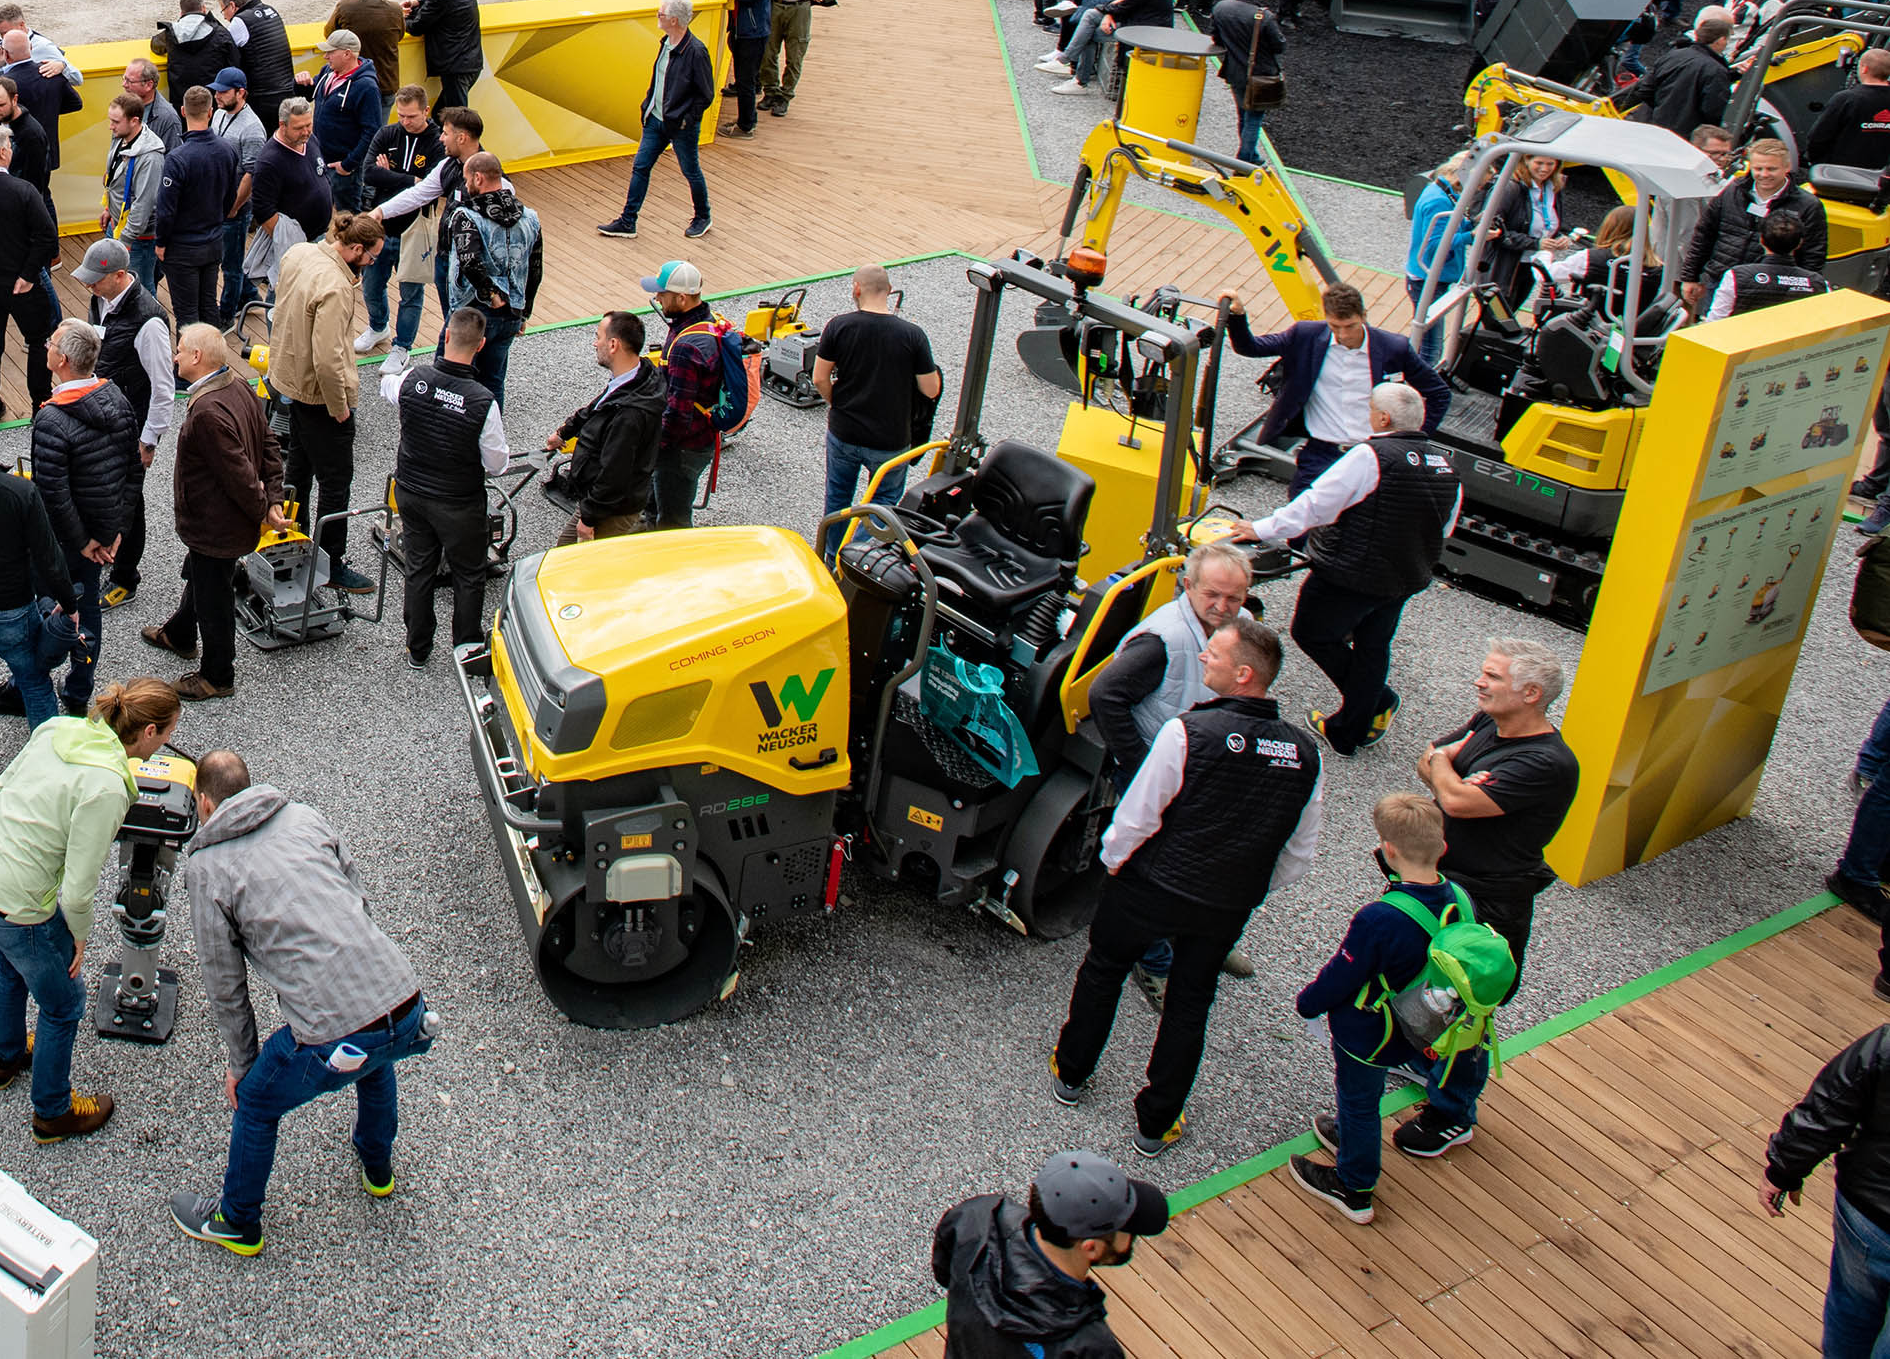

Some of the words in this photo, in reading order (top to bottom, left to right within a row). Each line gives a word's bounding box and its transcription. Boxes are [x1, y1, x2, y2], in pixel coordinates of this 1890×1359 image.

[434, 393, 464, 408] NEUSON
[435, 386, 464, 400] WACKER
[1473, 460, 1556, 498] EZ17e
[669, 645, 728, 671] COMING
[732, 627, 776, 649] SOON
[757, 723, 818, 743] WACKER
[757, 733, 818, 754] NEUSON
[1256, 738, 1298, 752] WACKER
[1256, 746, 1298, 761] NEUSON
[700, 793, 770, 817] RD28e
